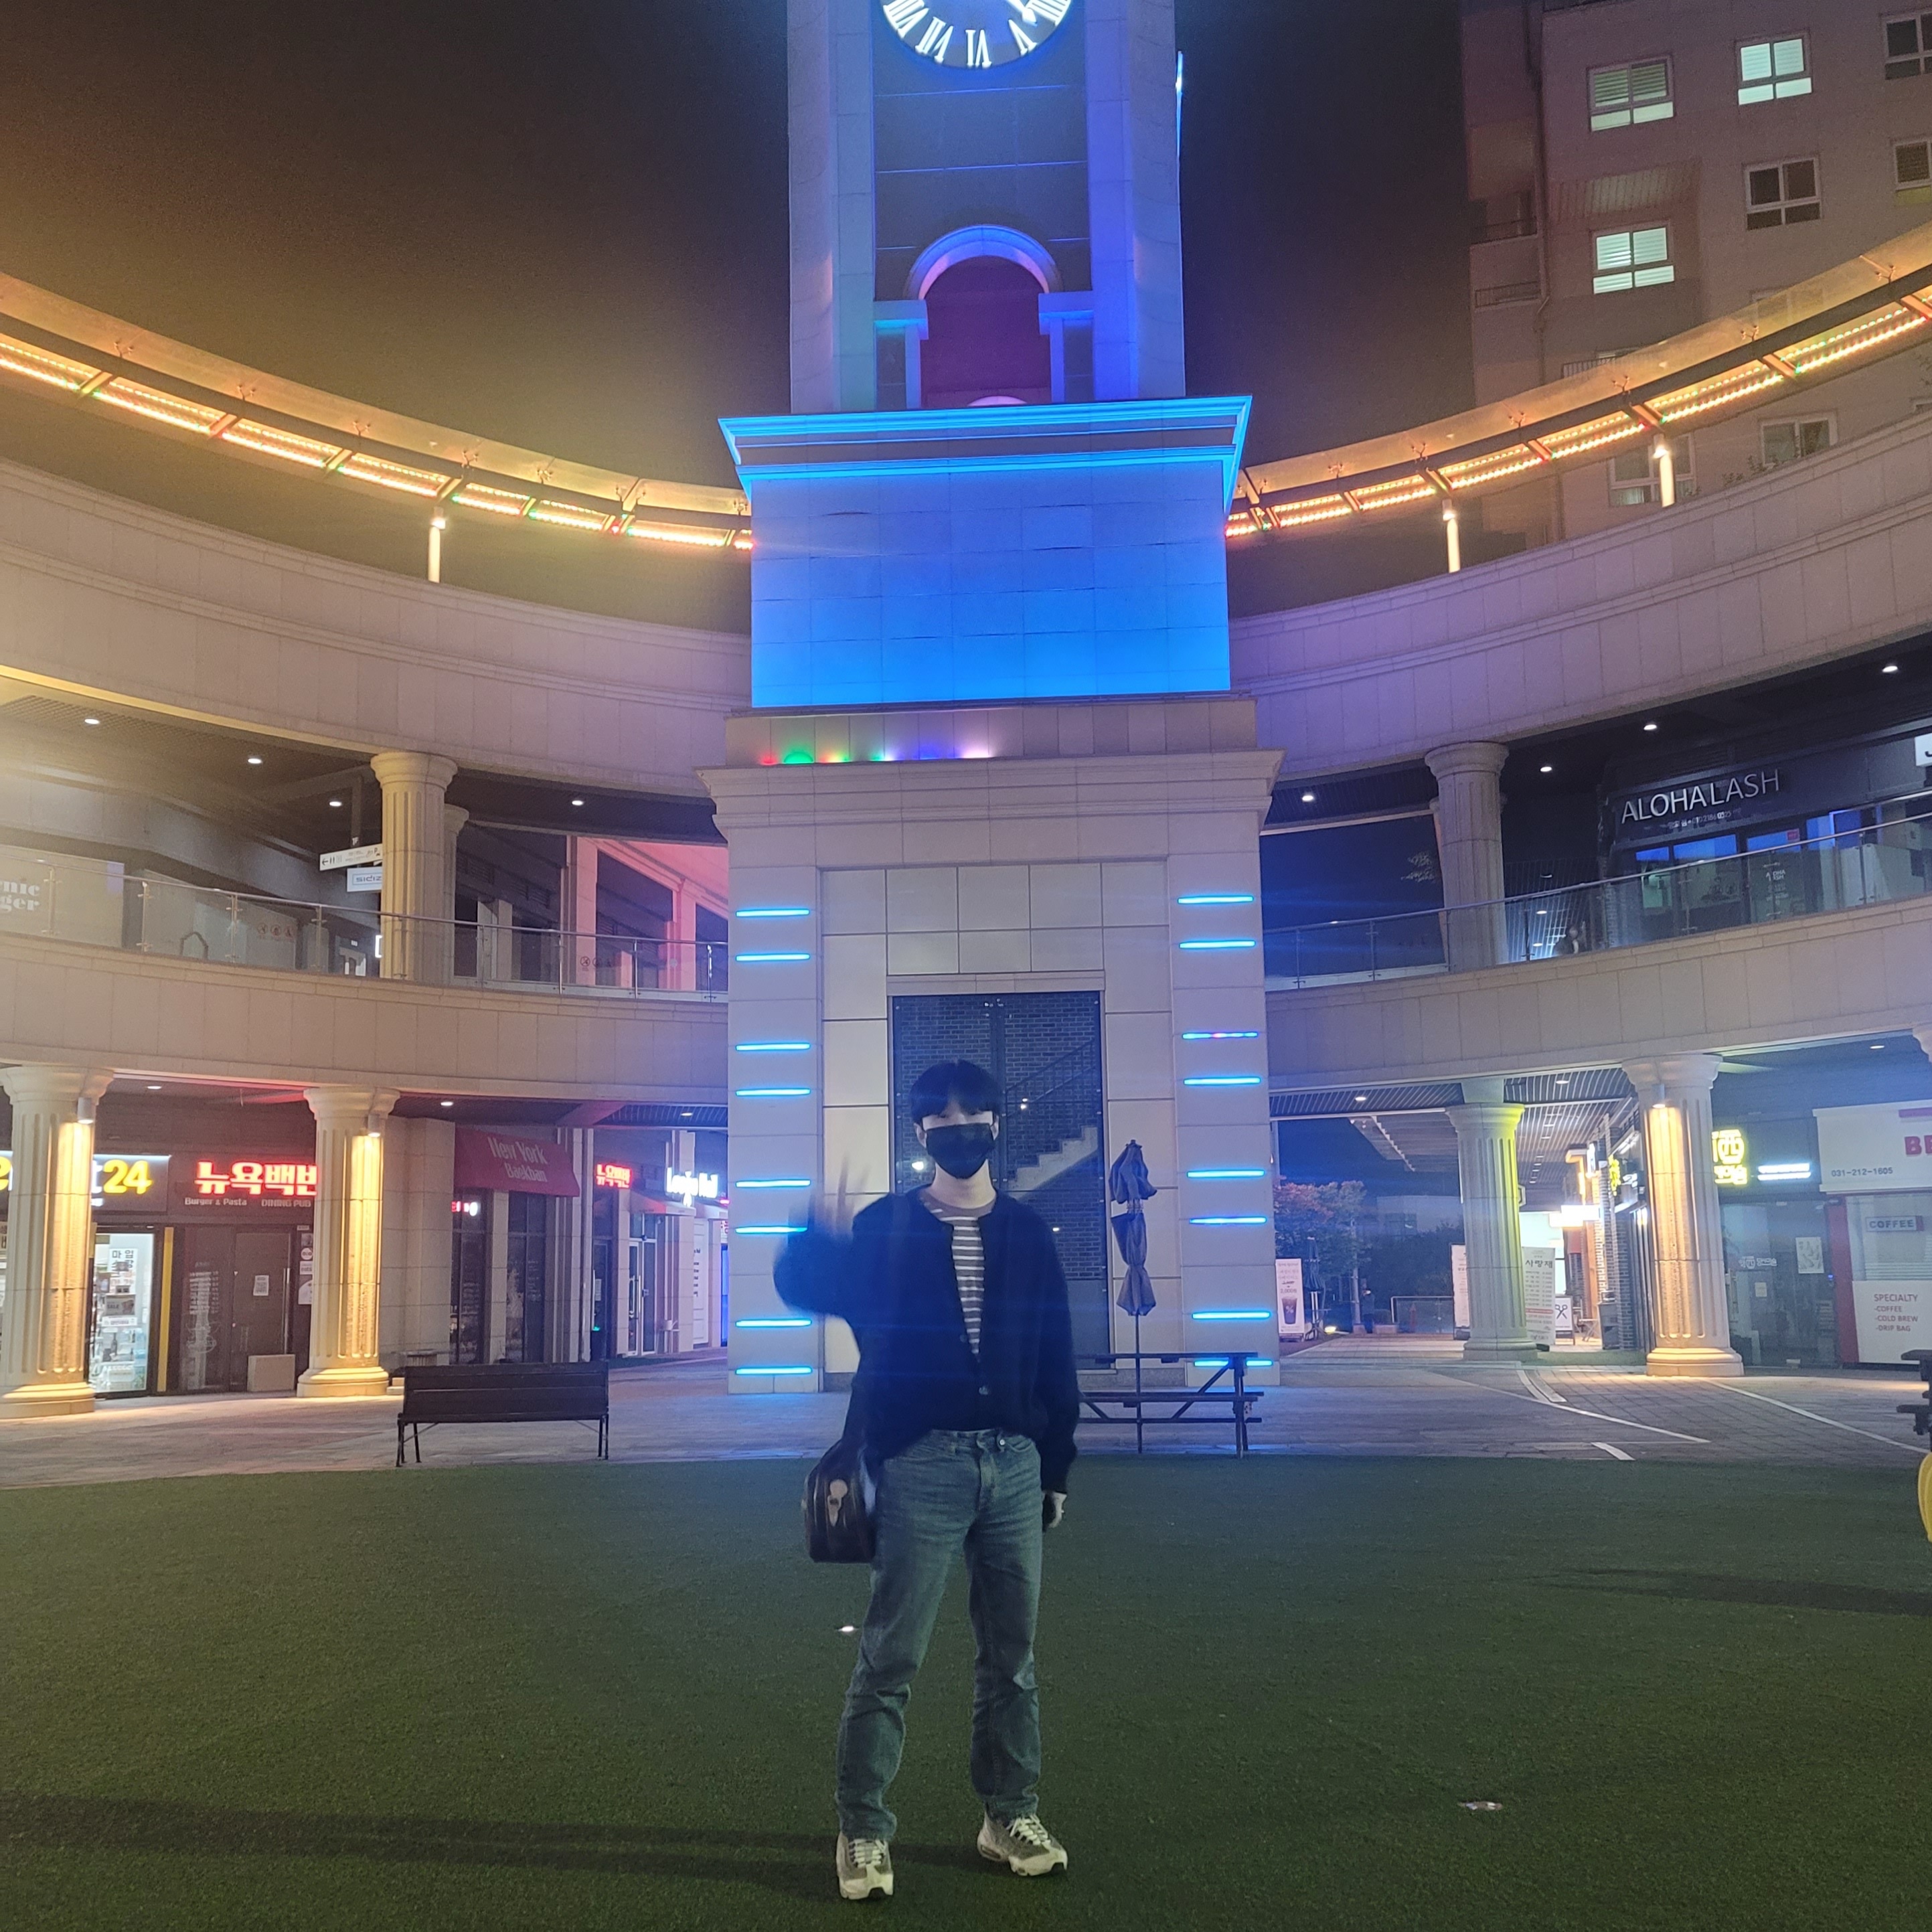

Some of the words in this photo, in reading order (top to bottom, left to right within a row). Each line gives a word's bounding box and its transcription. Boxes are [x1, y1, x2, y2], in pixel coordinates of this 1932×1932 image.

[0, 880, 40, 896] nic
[515, 1141, 548, 1165] York
[504, 1162, 548, 1182] Baekban
[1831, 1167, 1894, 1177] 031-212-1605
[185, 1197, 212, 1206] Burger
[223, 1198, 247, 1206] Pasta
[261, 1198, 291, 1207] DINING
[1869, 1219, 1915, 1229] COFFEE
[1874, 1293, 1918, 1302] SPECIALTY
